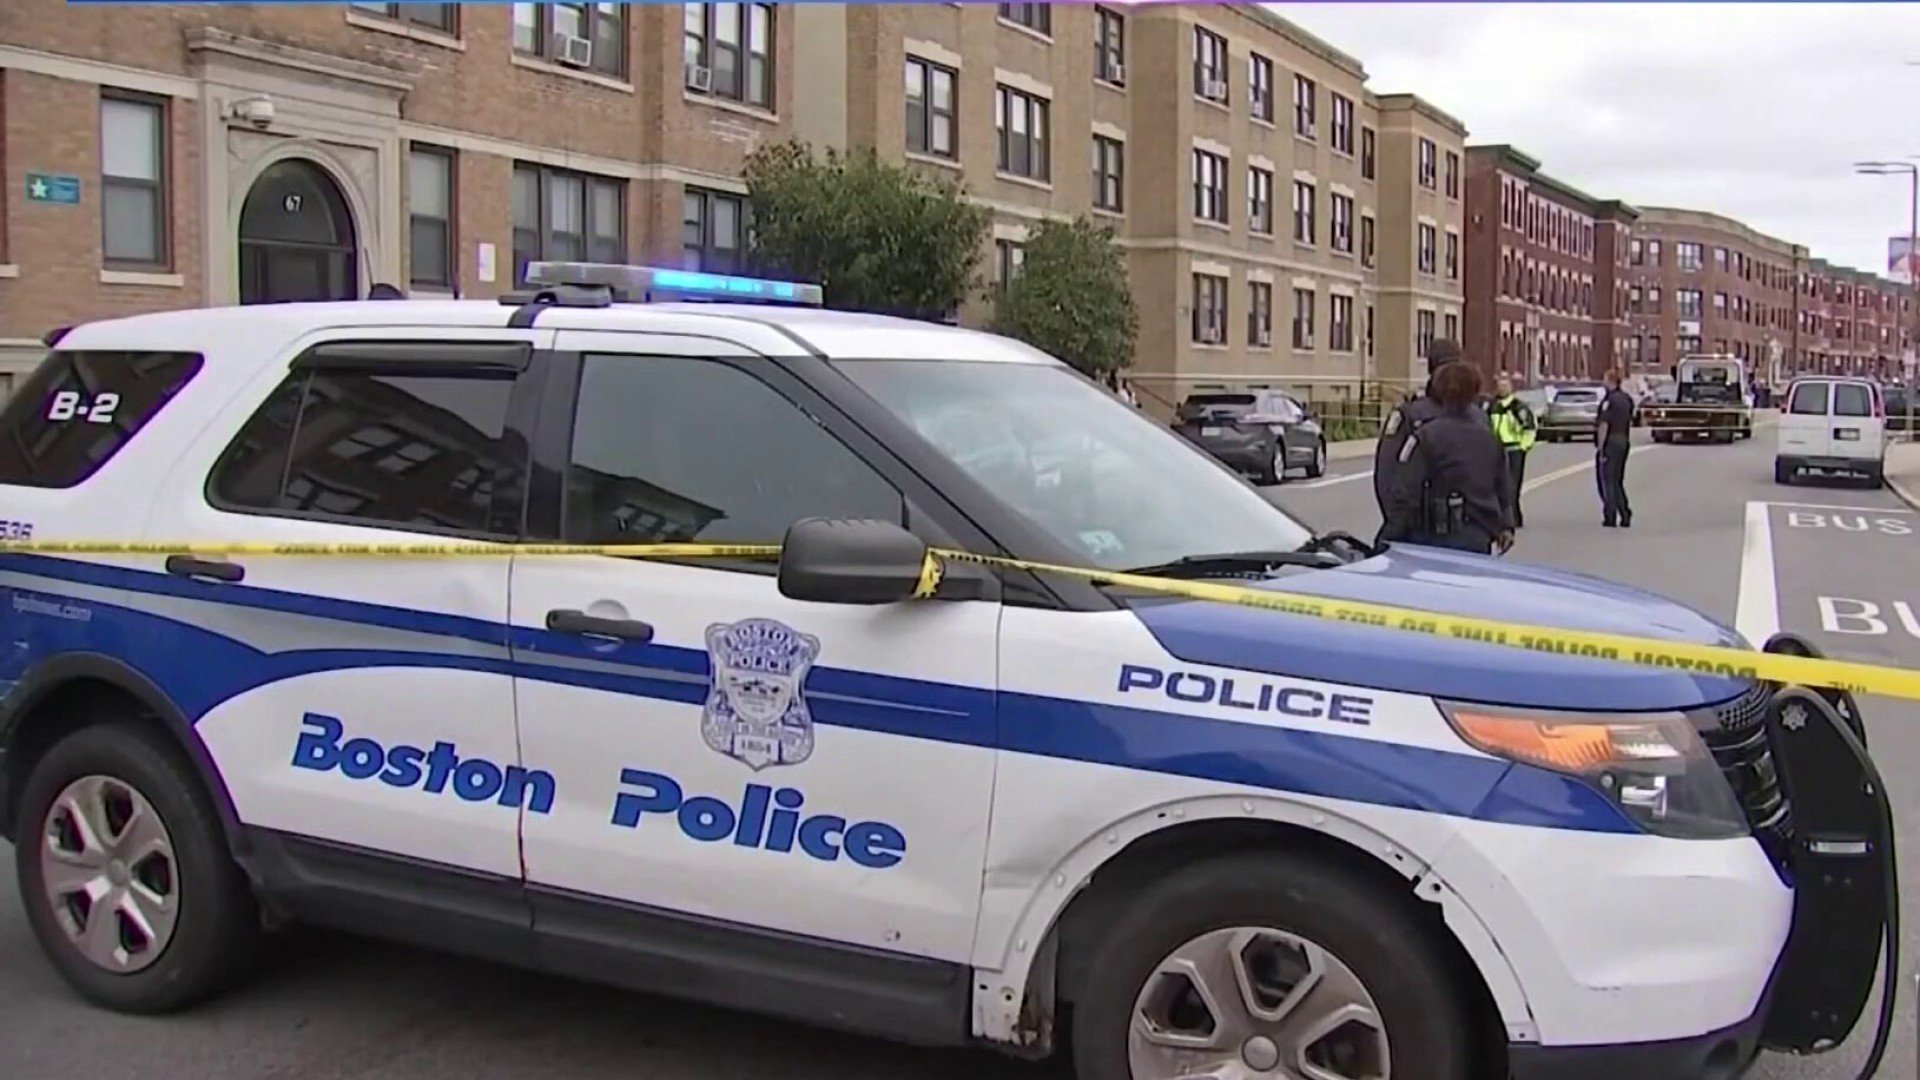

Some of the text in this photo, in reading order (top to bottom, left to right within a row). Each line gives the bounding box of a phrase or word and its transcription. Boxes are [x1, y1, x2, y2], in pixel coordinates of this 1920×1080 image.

[285, 195, 301, 212] 67
[48, 390, 120, 423] B-2
[1788, 512, 1913, 534] BUS
[730, 653, 791, 674] POLICE
[1118, 664, 1374, 725] POLICE
[291, 712, 907, 869] Boston Police
